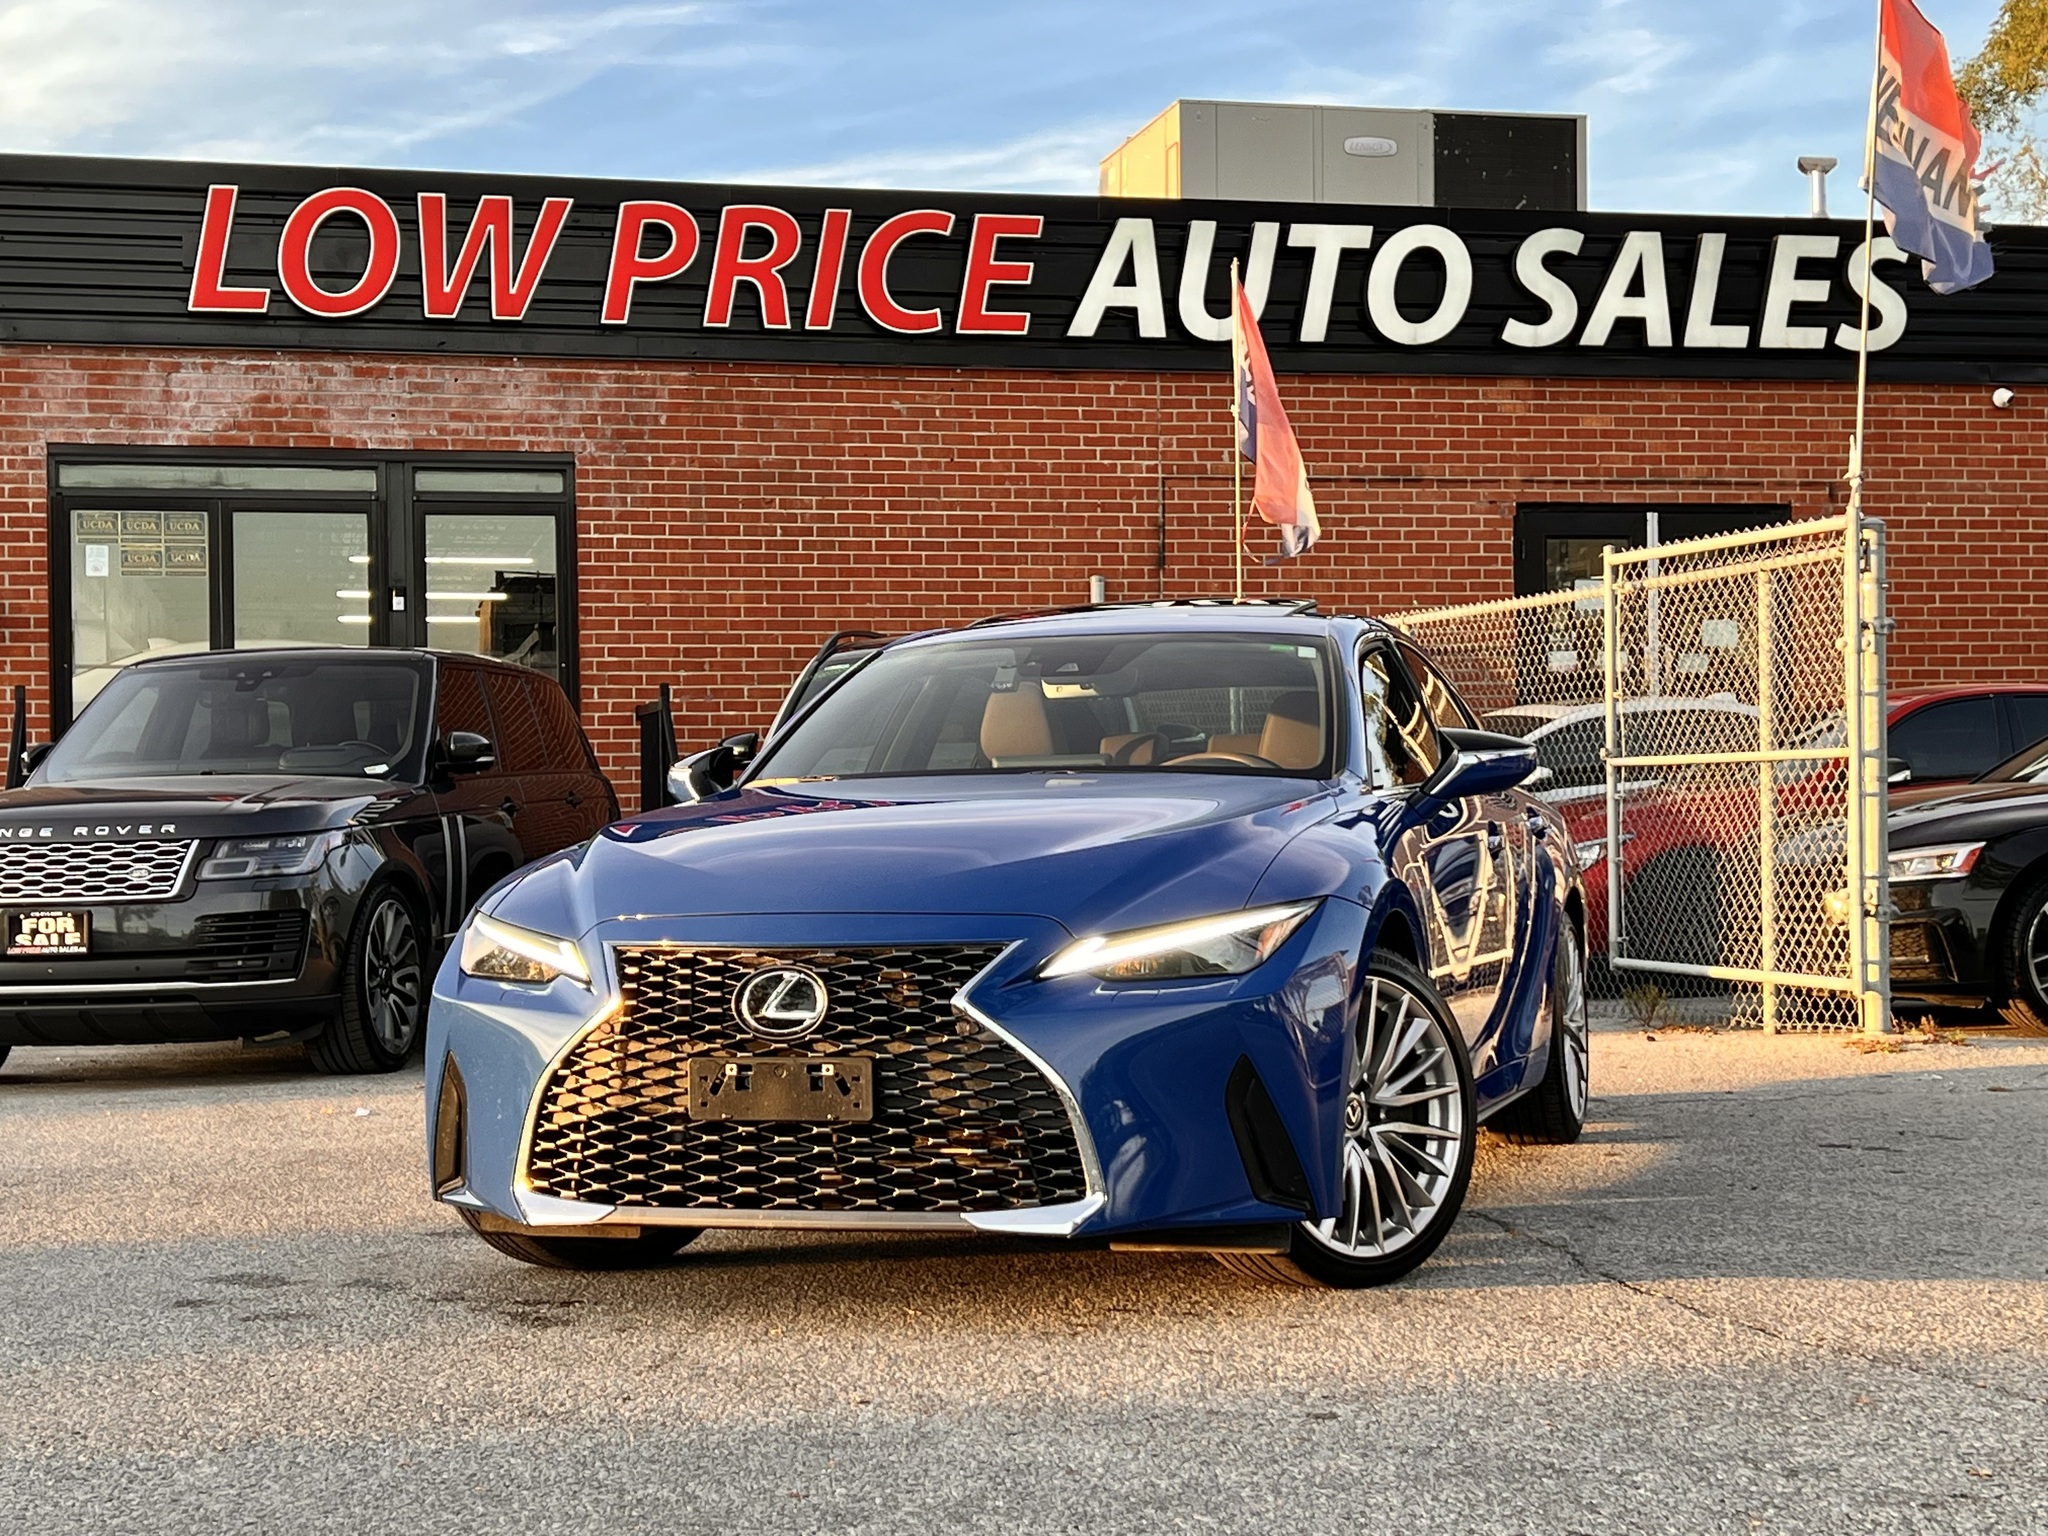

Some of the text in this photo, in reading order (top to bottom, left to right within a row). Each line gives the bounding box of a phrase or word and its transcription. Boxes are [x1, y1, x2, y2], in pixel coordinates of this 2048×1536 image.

[187, 184, 1909, 352] LOW PRICE AUTO SALES
[82, 521, 114, 530] UCDA
[126, 521, 157, 531] UCDA
[169, 522, 200, 531] UCDA
[127, 554, 157, 563] UCDA
[170, 552, 201, 562] UCDA
[73, 824, 176, 836] ROVER
[22, 917, 75, 934] FOR
[15, 931, 81, 946] SALE
